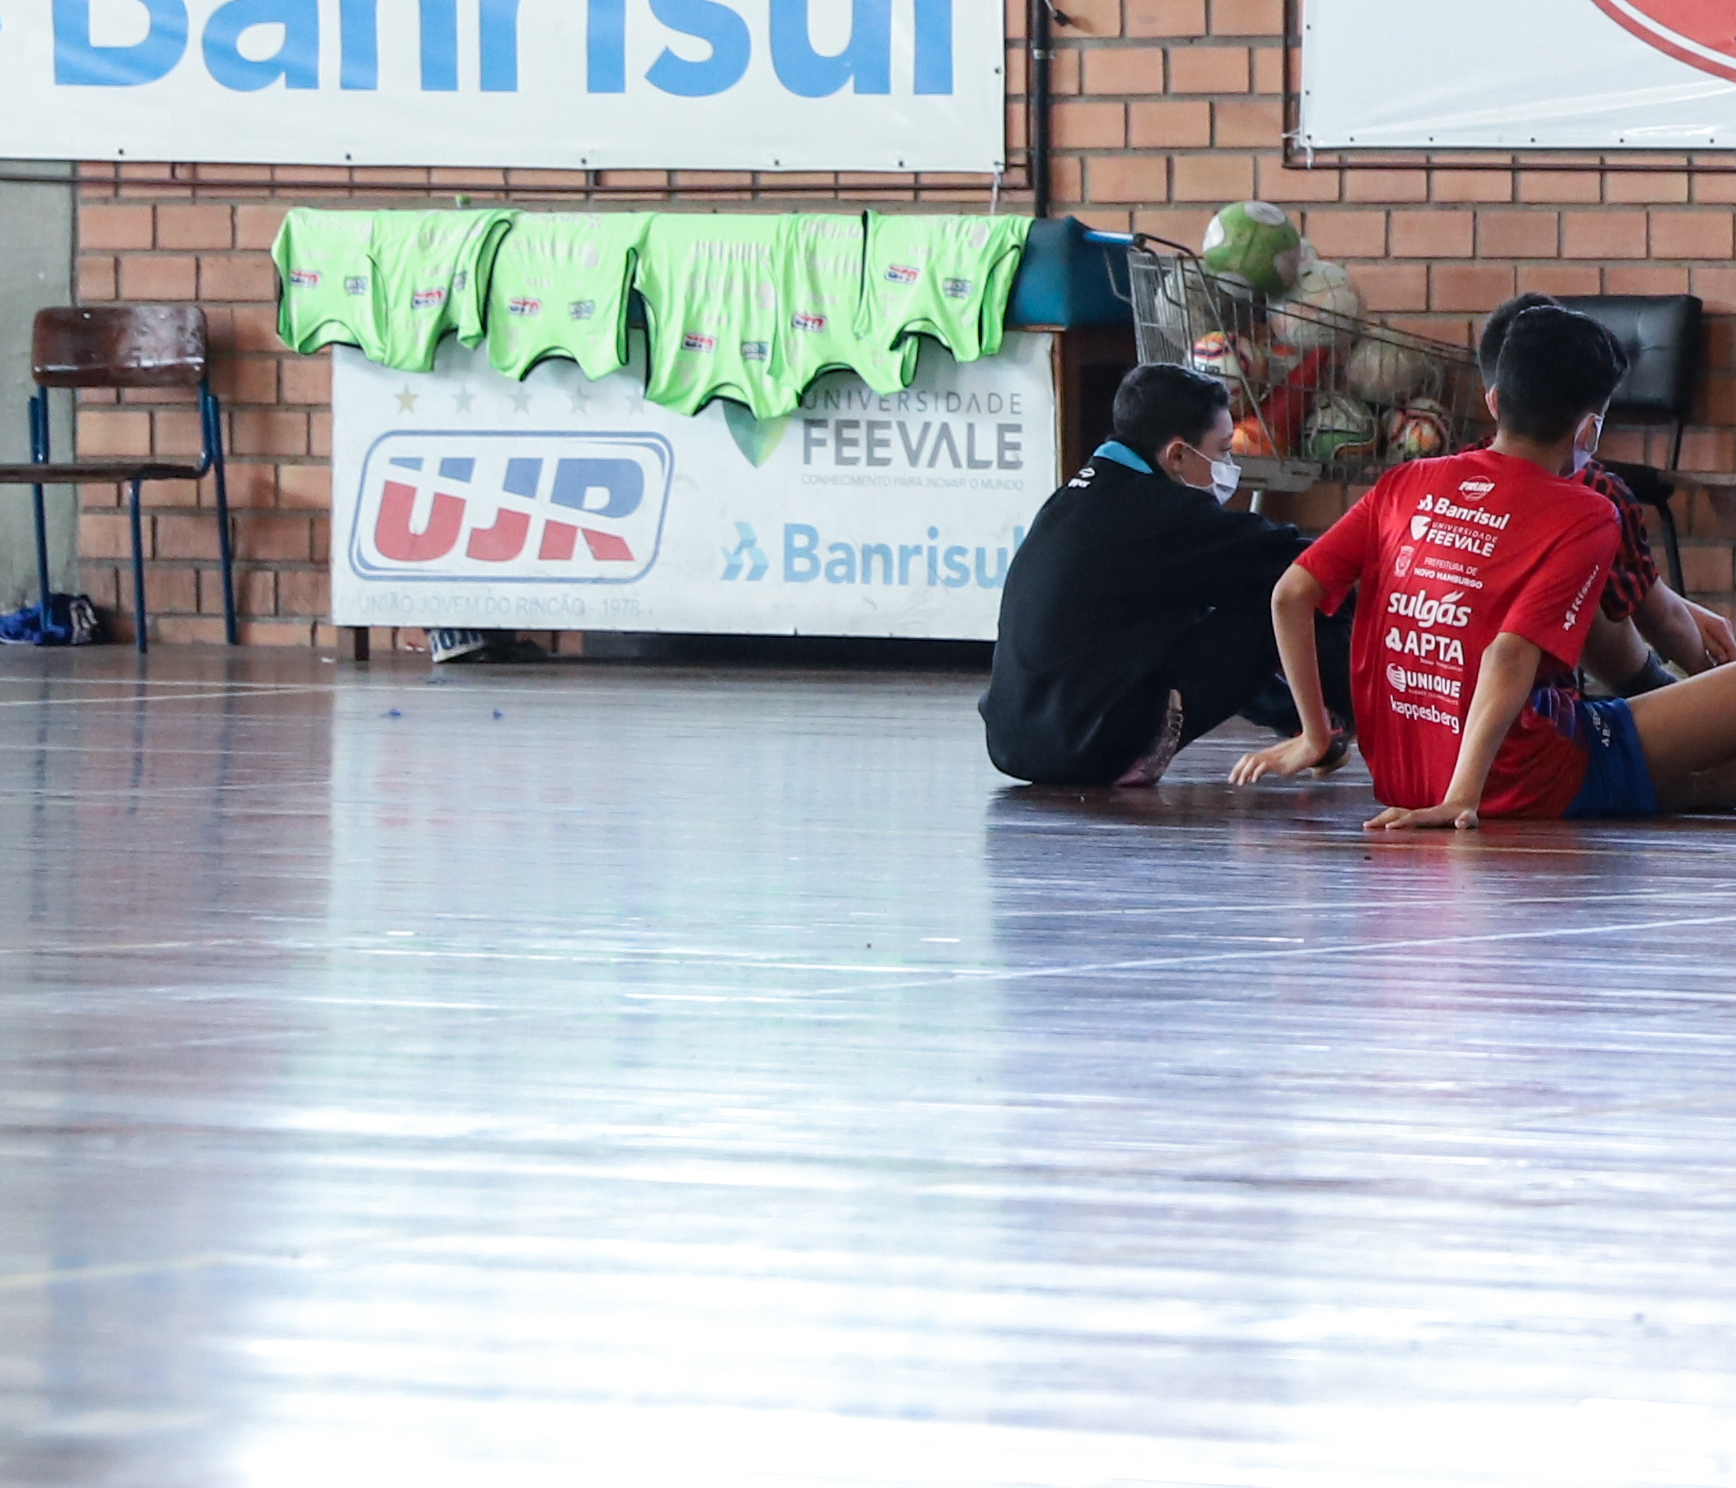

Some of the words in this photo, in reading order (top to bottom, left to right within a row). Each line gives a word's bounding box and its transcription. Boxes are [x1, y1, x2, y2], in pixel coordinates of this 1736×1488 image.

[803, 418, 1024, 470] FEEVALE
[373, 456, 645, 563] UJR
[1433, 497, 1511, 530] Banrisul
[1426, 529, 1494, 557] FEEVALE
[1432, 522, 1498, 543] UNIVERSIDADE
[1404, 630, 1465, 666] APTA
[1406, 671, 1462, 698] UNIQUE
